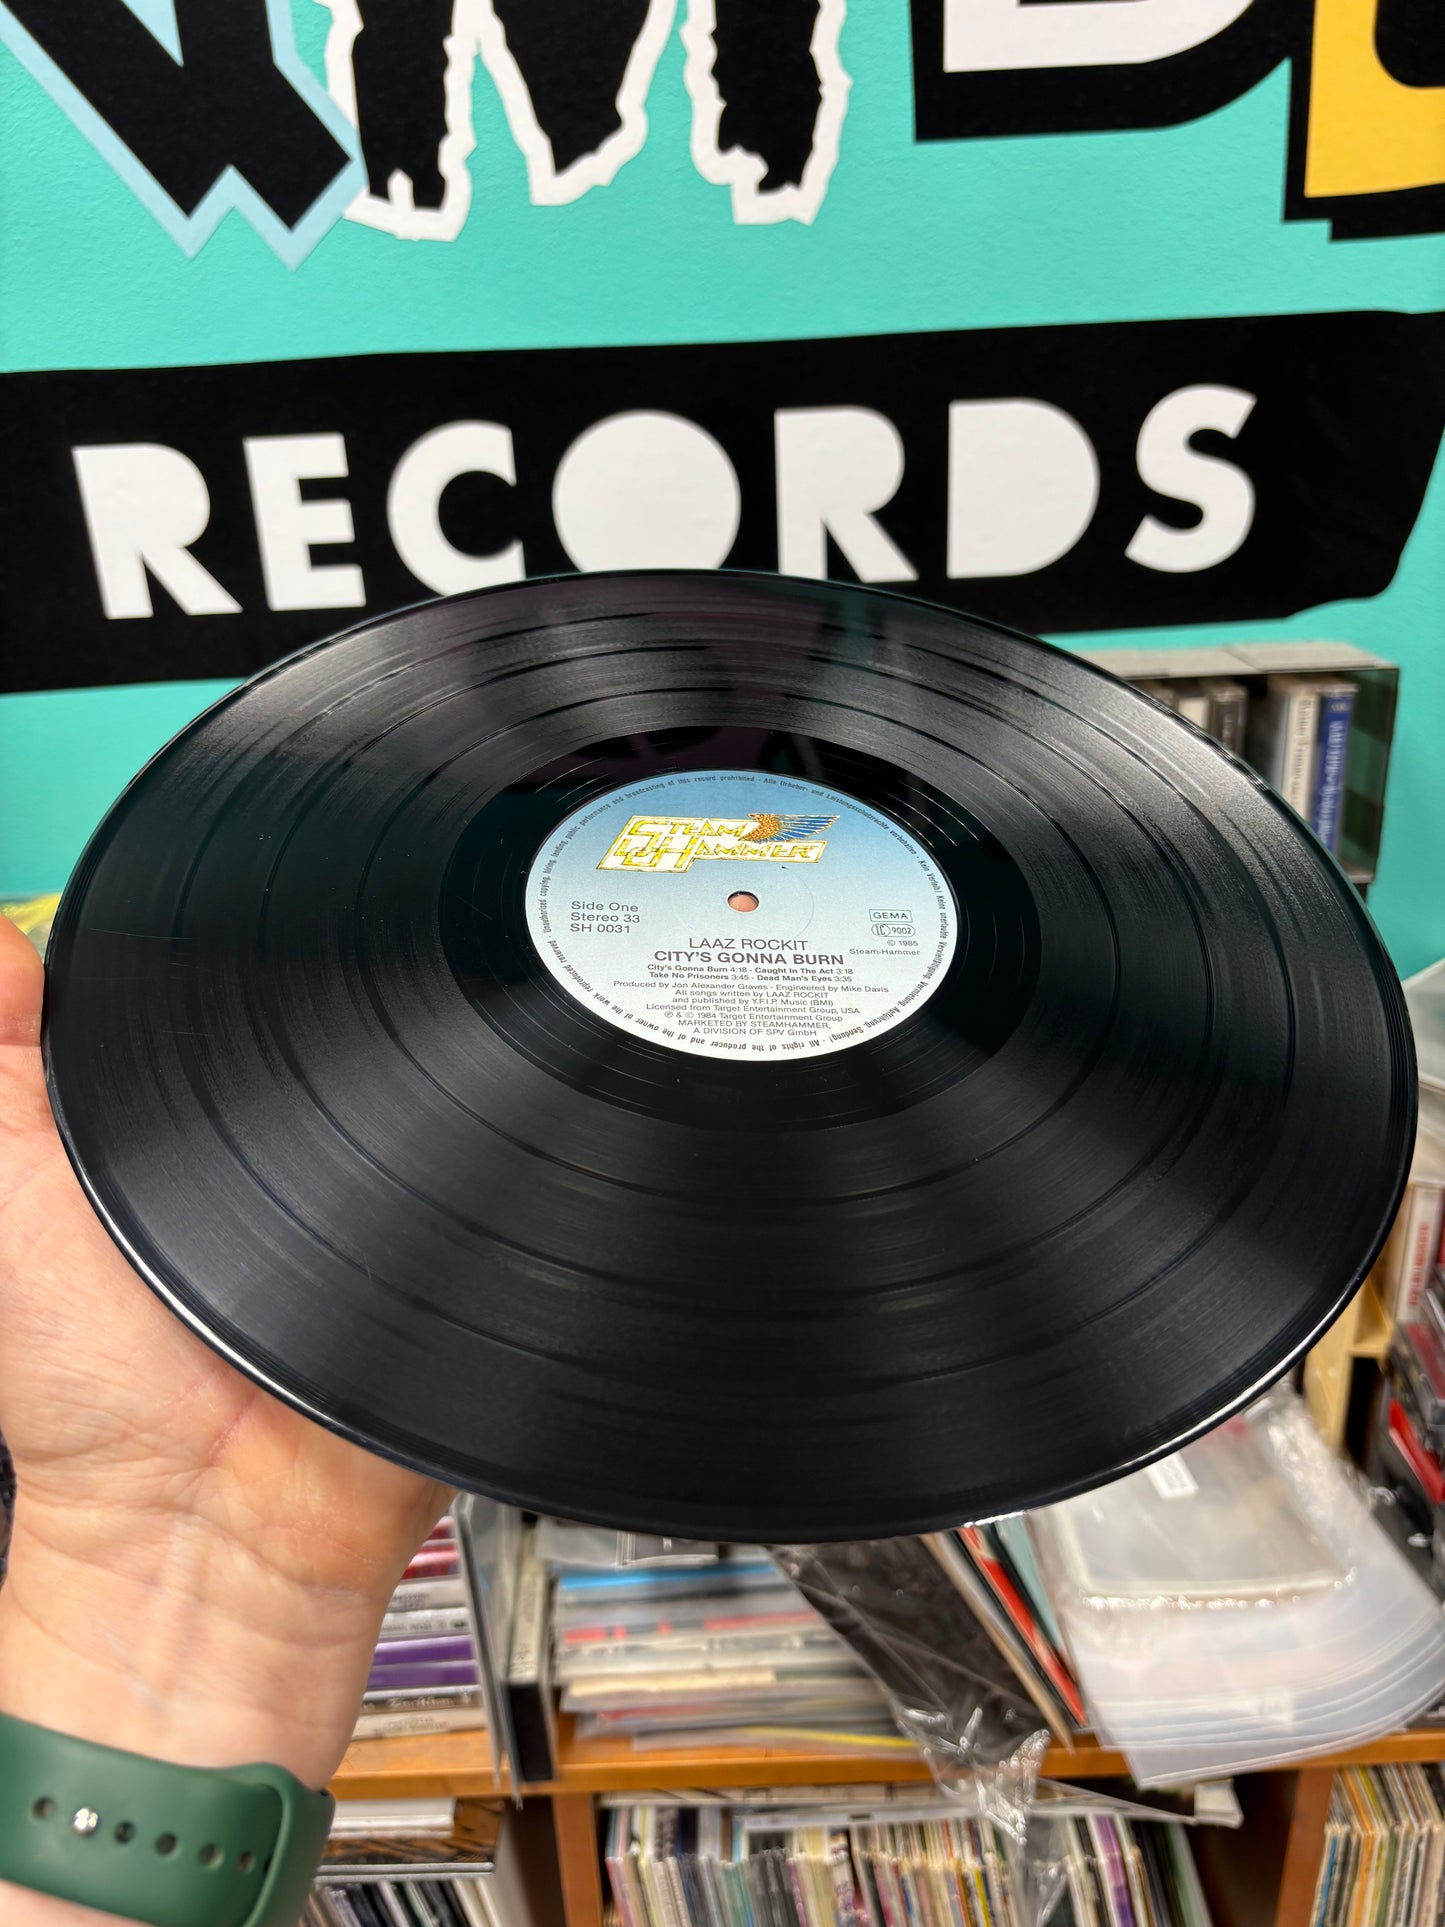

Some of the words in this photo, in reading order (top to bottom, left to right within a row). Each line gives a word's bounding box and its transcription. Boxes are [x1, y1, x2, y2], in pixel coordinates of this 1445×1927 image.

[74, 384, 1257, 619] RECORDS
[624, 782, 666, 799] broadcasting
[780, 780, 808, 791] Urheber-
[580, 804, 611, 826] performance
[565, 826, 580, 840] public
[614, 818, 748, 857] STEAM
[622, 834, 819, 868] HAMMER
[918, 860, 930, 872] Kein
[571, 901, 604, 910] Side
[608, 902, 638, 912] One
[936, 896, 946, 910] Keine
[539, 900, 552, 933] Unauthorised
[570, 912, 619, 922] Stereo
[623, 914, 640, 923] 33
[570, 923, 592, 932] SH
[597, 924, 630, 934] 0031
[892, 926, 912, 934] 9002
[689, 938, 735, 949] LAAZ
[741, 938, 808, 951] ROCKIT
[547, 940, 568, 964] reserved
[654, 951, 712, 963] CITY'S
[717, 952, 787, 964] GONNA
[792, 954, 844, 965] BURN
[562, 964, 594, 992] reproduced
[691, 982, 735, 990] Alexander
[828, 985, 838, 993] by
[593, 992, 610, 1006] work
[738, 998, 749, 1006] by
[612, 1004, 624, 1014] the
[743, 1005, 806, 1013] Entertainment
[815, 1014, 843, 1022] Group
[635, 1018, 660, 1031] owner
[662, 1028, 675, 1038] the
[690, 1036, 705, 1044] and
[710, 1040, 746, 1050] producer
[809, 1040, 820, 1048] All
[782, 1042, 804, 1050] rights
